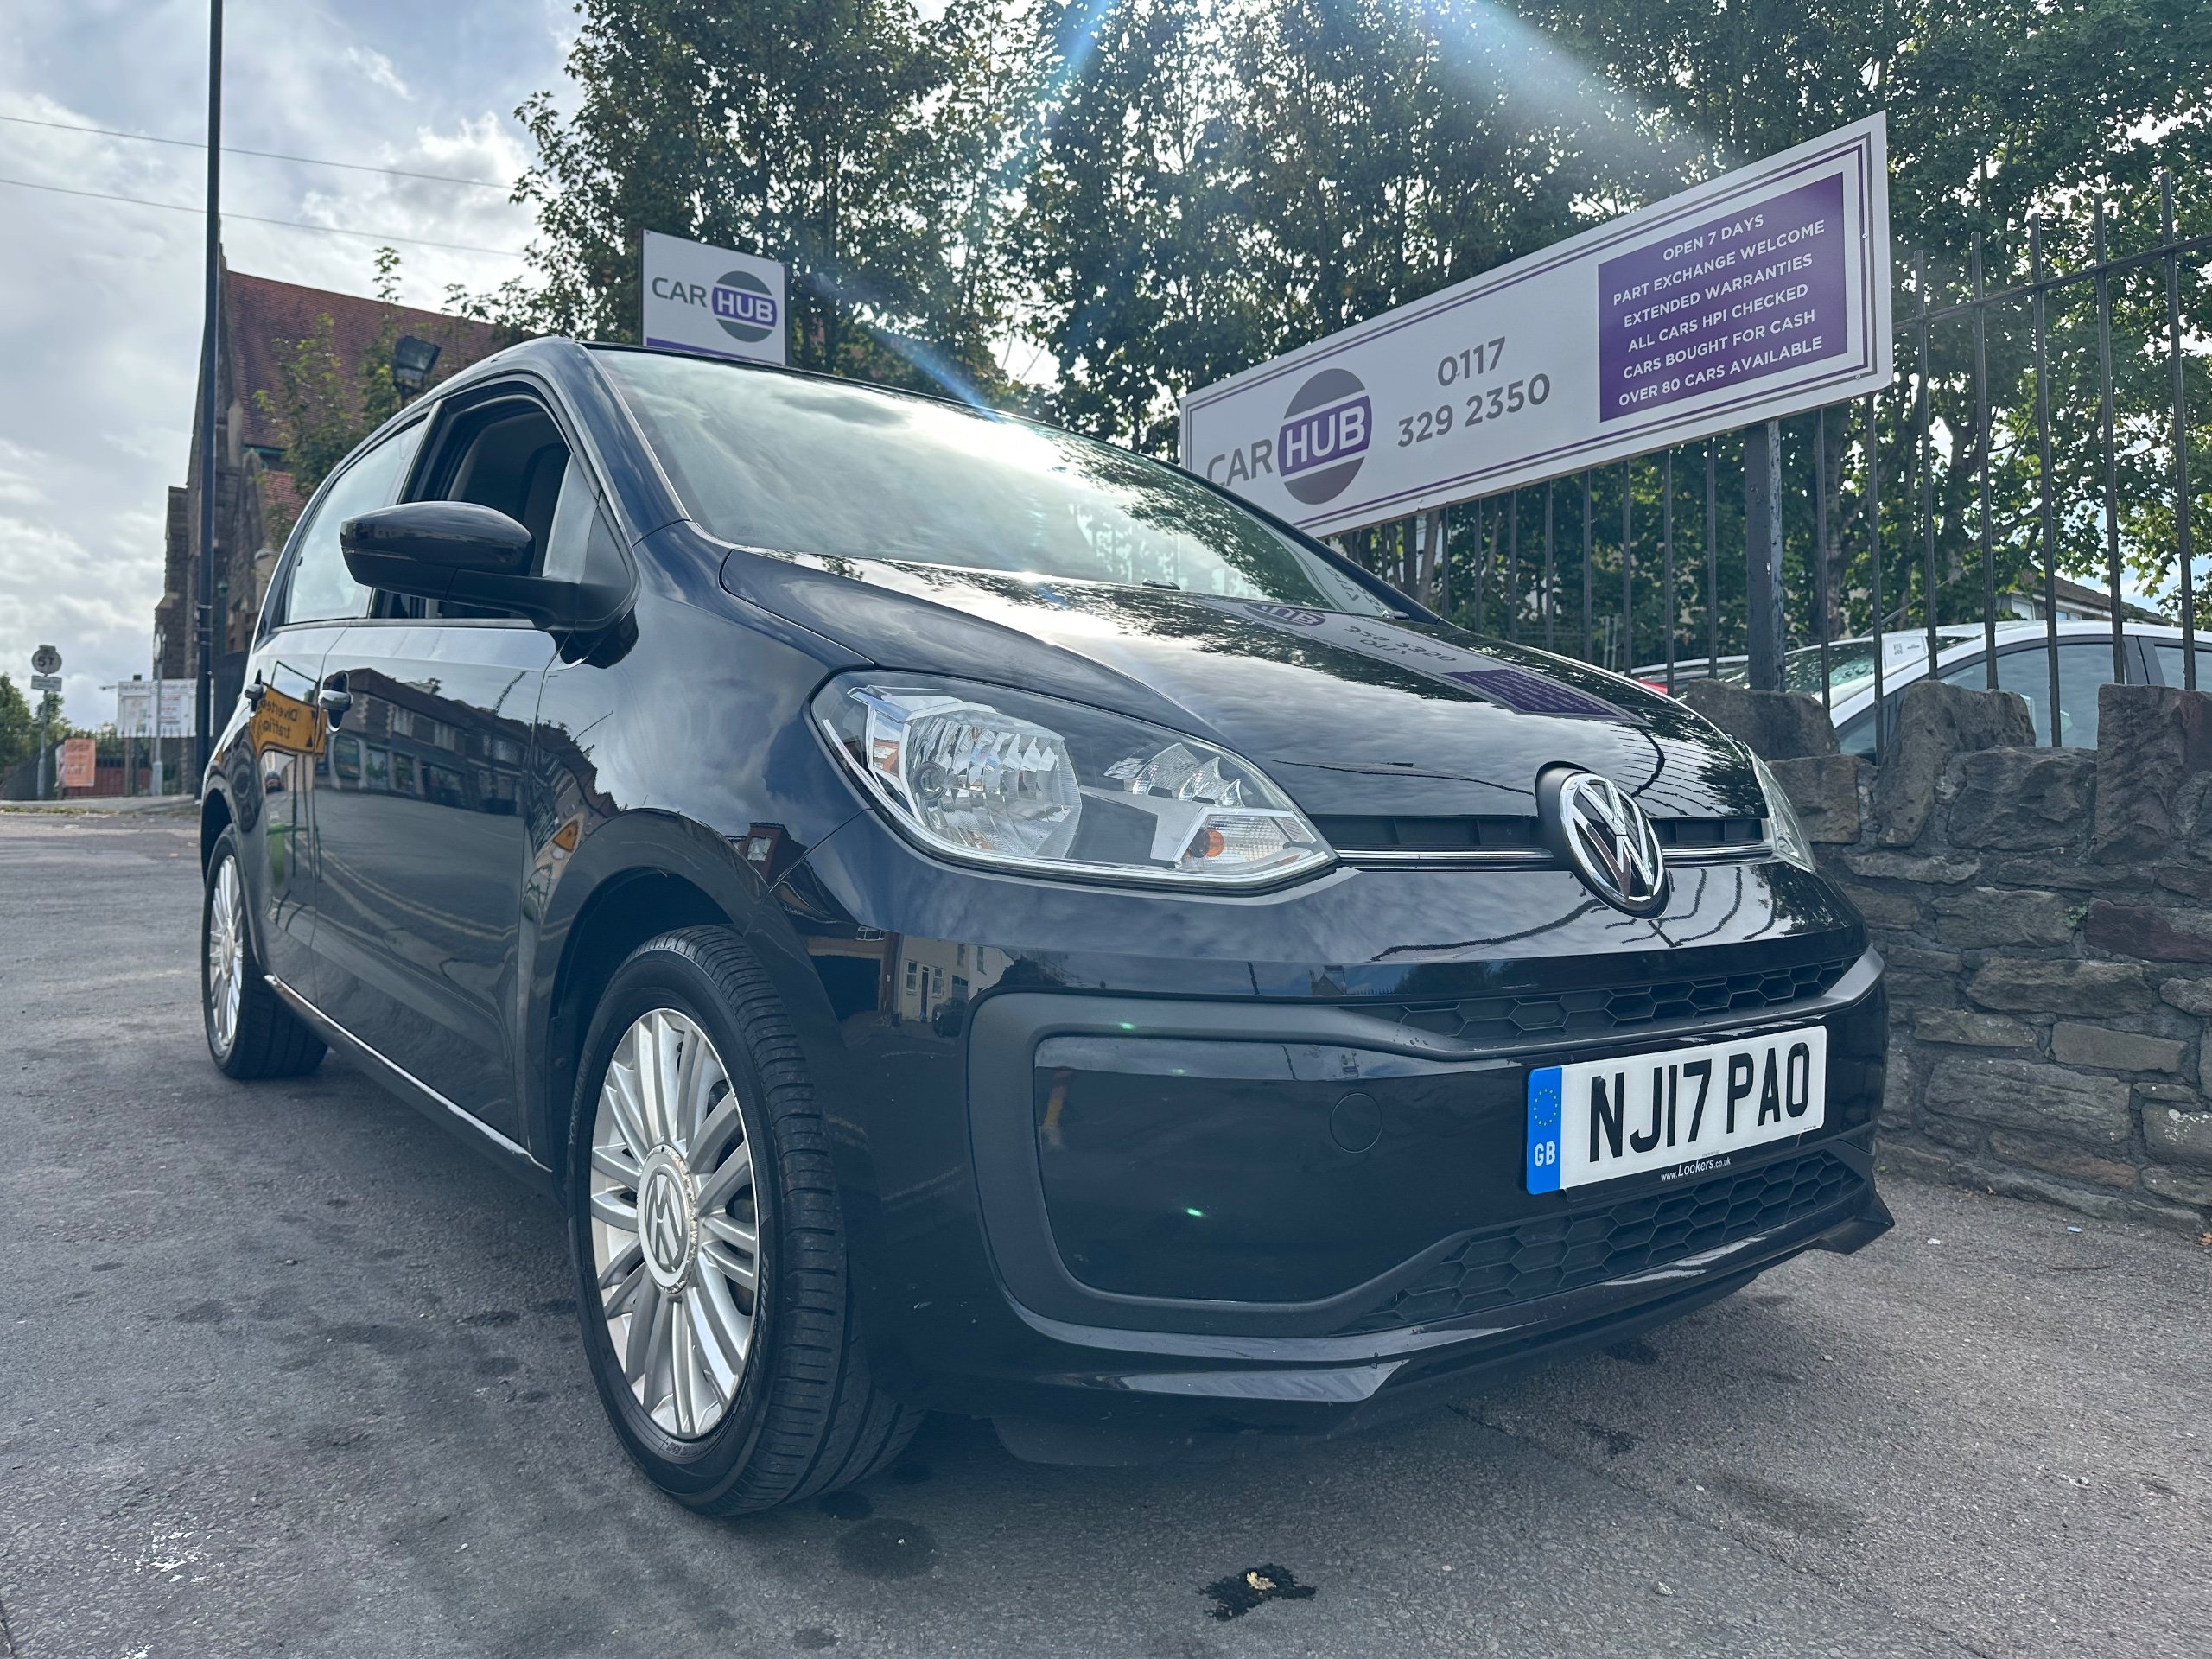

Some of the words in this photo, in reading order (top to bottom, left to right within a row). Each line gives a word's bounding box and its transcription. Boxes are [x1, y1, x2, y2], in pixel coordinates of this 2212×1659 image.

[1613, 282, 1649, 305] PART
[1654, 251, 1736, 291] EXCHANGE
[1739, 219, 1825, 260] WELCOME
[1663, 237, 1703, 261] OPEN
[1708, 232, 1717, 245] 7
[1721, 214, 1764, 240] DAYS
[652, 277, 708, 308] CAR
[717, 290, 773, 323] HUB
[1624, 292, 1700, 327] EXTENDED
[1705, 253, 1813, 300] WARRANTIES
[1628, 336, 1655, 353] ALL
[1658, 319, 1698, 342] CARS
[1702, 310, 1727, 328] HPI
[1732, 283, 1808, 318] CHECKED
[1437, 336, 1506, 387] 0117
[1618, 385, 1658, 406] OVER
[1662, 378, 1681, 393] 80
[1685, 365, 1726, 387] CARS
[1729, 336, 1822, 375] AVAILABLE
[1623, 357, 1662, 379] CARS
[1665, 335, 1728, 367] BOUGHT
[1732, 325, 1765, 346] FOR
[1770, 309, 1815, 334] CASH
[1207, 439, 1273, 486] CAR
[1286, 405, 1365, 468] HUB
[1397, 404, 1453, 448] 329
[1465, 373, 1551, 428] 2350
[1589, 1058, 1713, 1163] NJ17
[1726, 1042, 1810, 1135] PAO
[1534, 1141, 1556, 1167] GB
[1661, 1156, 1732, 1182] www.Lookers.co.uk
